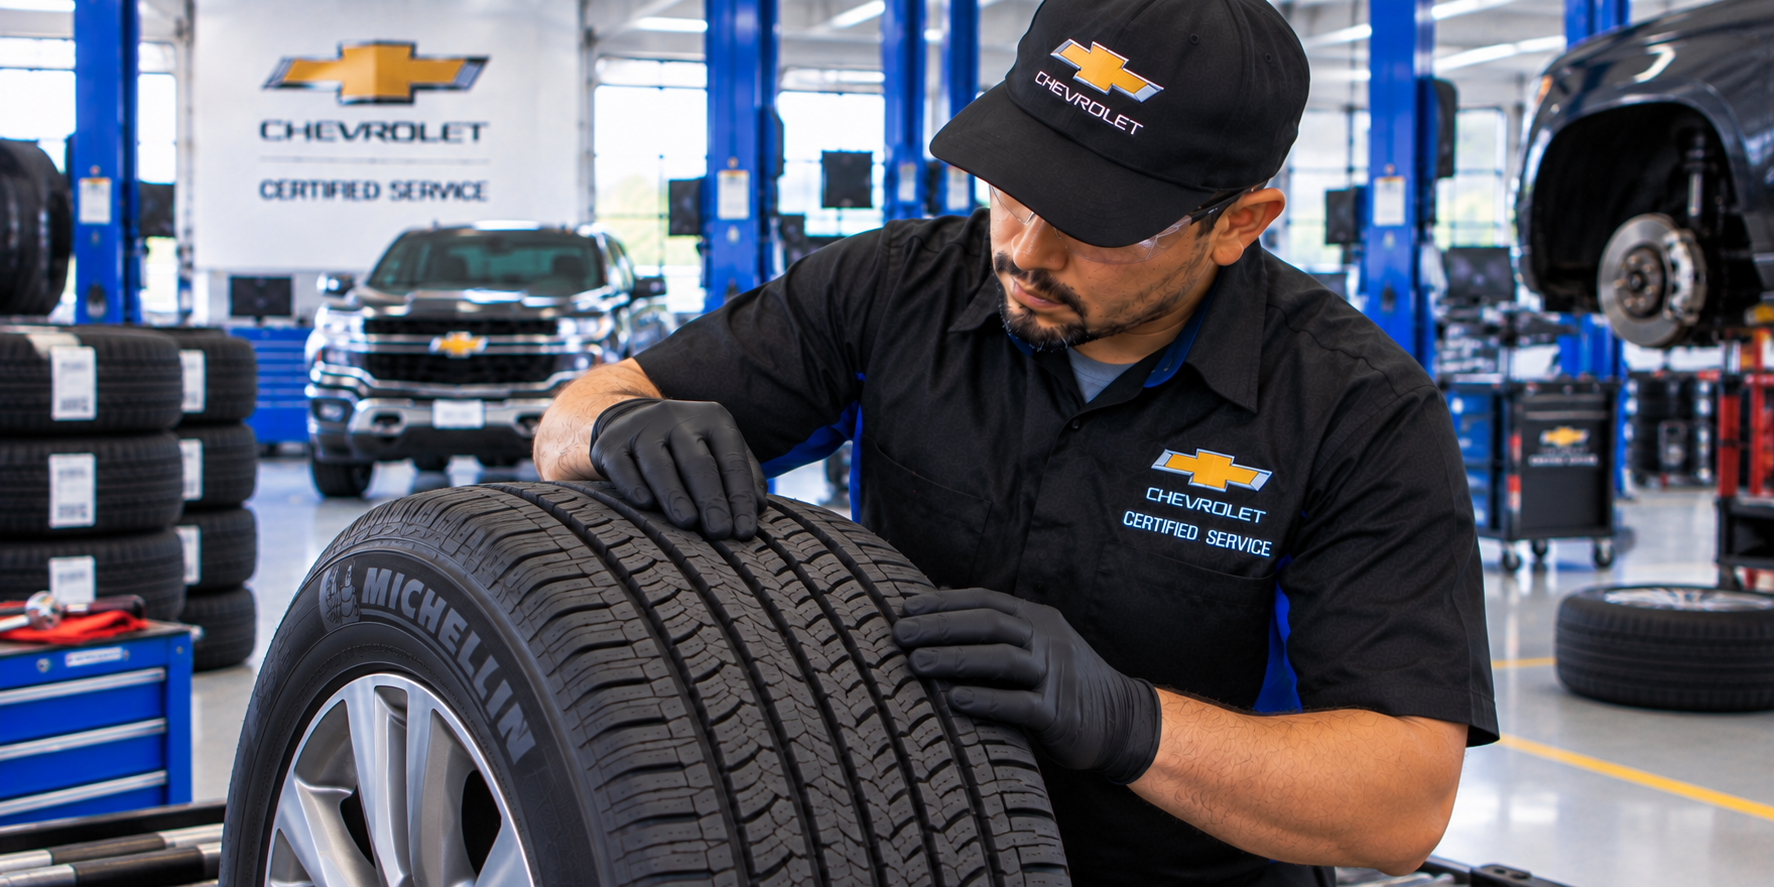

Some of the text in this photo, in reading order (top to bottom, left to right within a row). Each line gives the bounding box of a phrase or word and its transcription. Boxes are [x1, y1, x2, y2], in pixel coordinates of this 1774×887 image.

[1034, 70, 1144, 135] CHEVROLET
[260, 119, 489, 143] CHEVROLET
[259, 179, 489, 201] CERTIFIED SERVICE
[1146, 486, 1267, 524] CHEVROLET
[1123, 510, 1273, 557] CERTIFIED SERVICE
[361, 567, 536, 765] MICHELLIN
